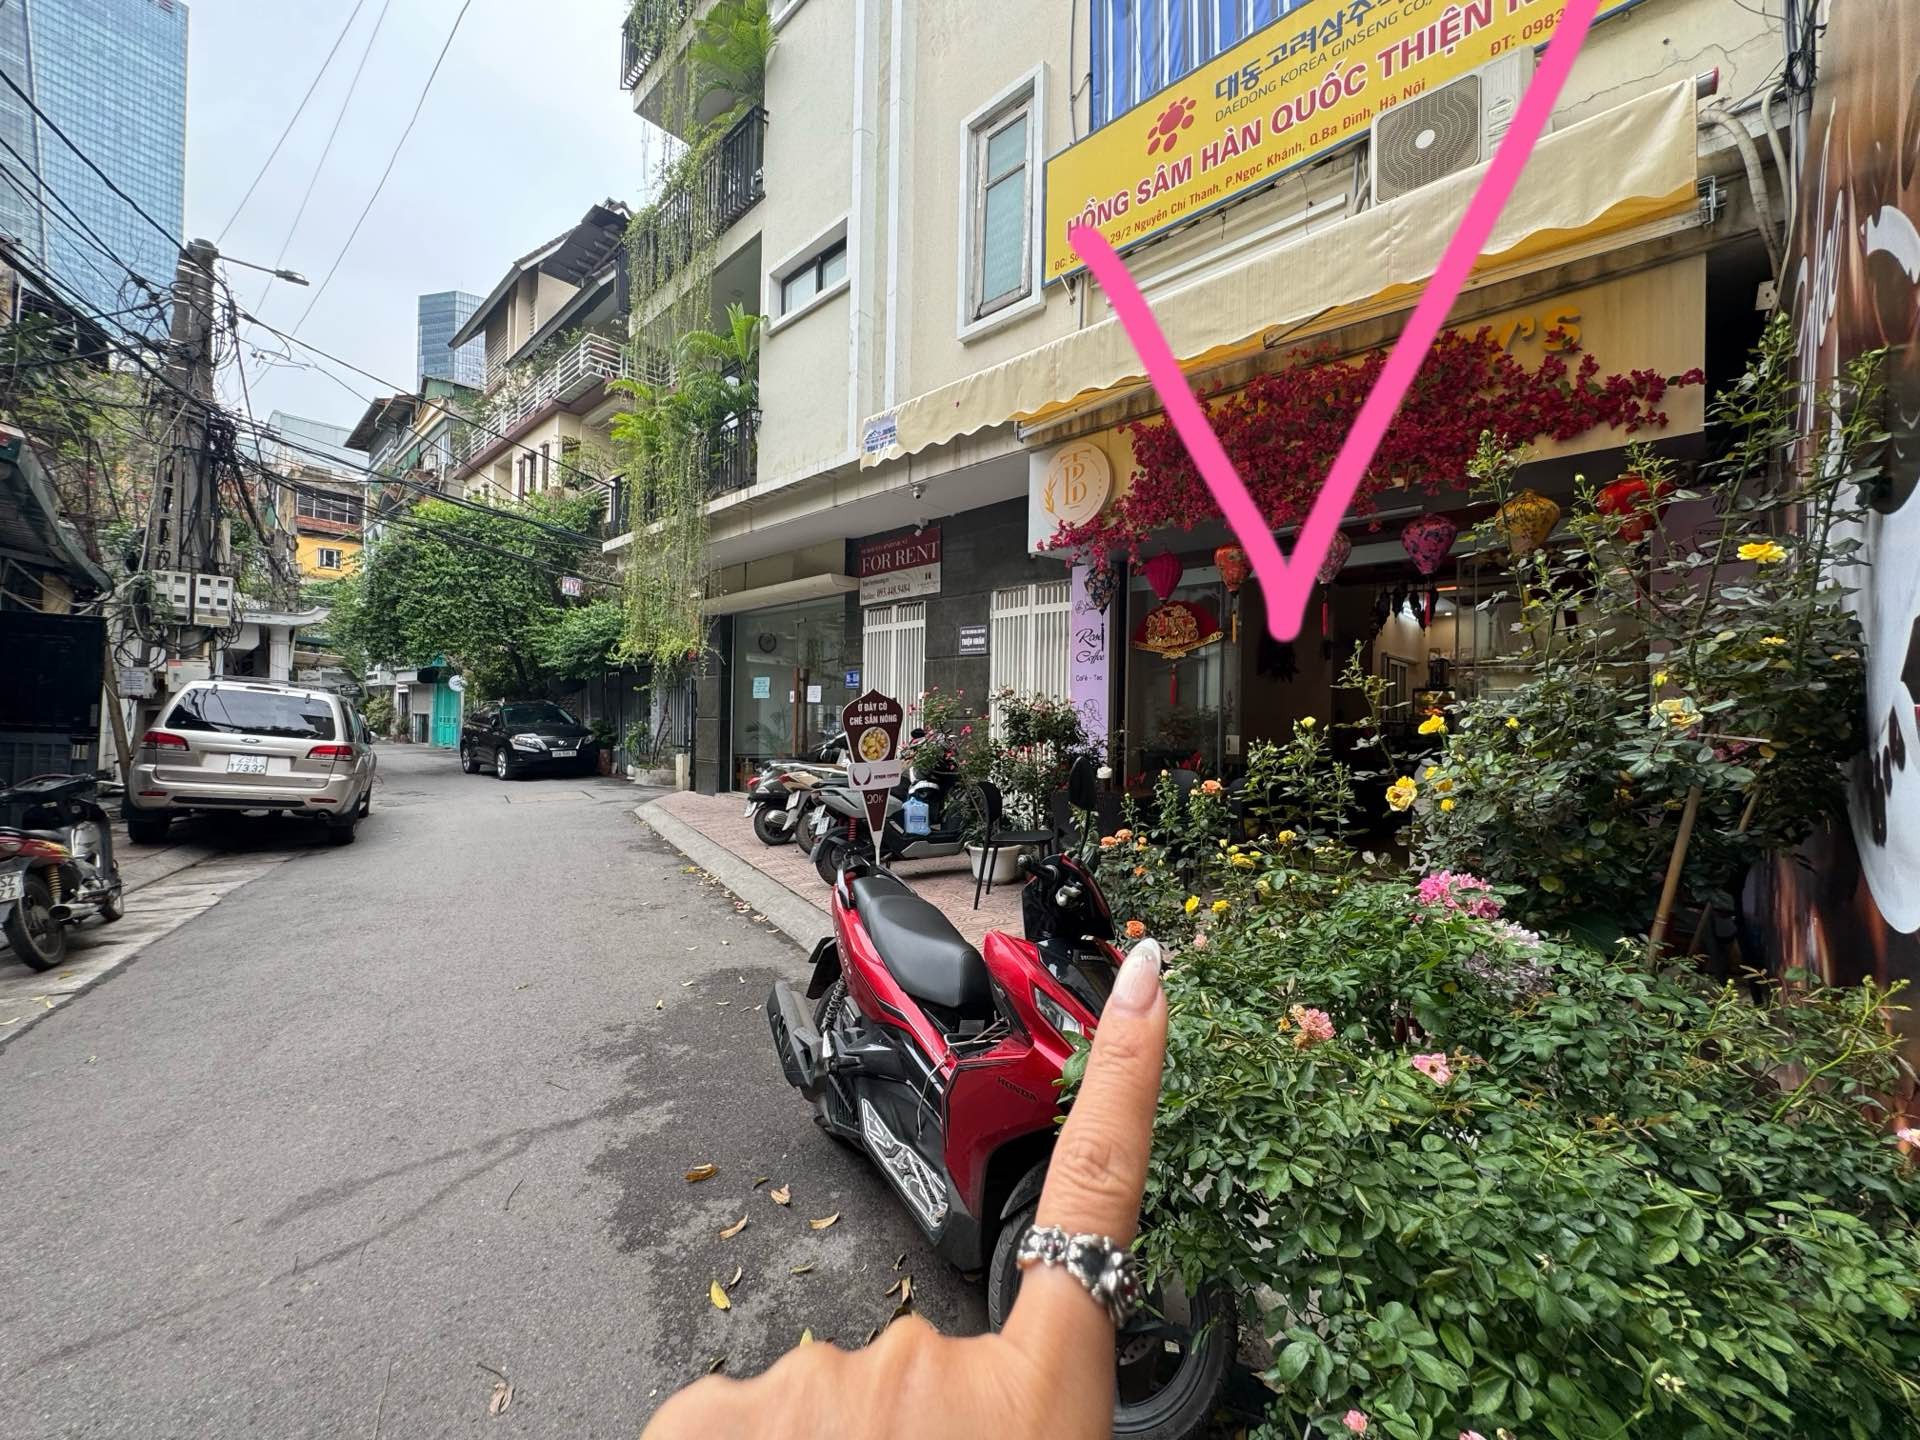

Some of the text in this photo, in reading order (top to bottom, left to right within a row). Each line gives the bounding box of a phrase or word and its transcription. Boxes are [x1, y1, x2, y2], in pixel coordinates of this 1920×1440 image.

[1491, 34, 1516, 56] ĐT:
[1215, 80, 1277, 122] DAEDONG
[1280, 53, 1327, 86] KOREA
[1331, 11, 1398, 57] GINSENG
[1136, 155, 1192, 205] SÂM
[1201, 119, 1262, 172] HÀN
[1271, 60, 1367, 134] QUỐC
[1377, 0, 1492, 79] THIỆN
[1110, 226, 1131, 245] 29/2
[1171, 197, 1186, 214] Chí
[1190, 184, 1221, 206] Thanh,
[1225, 162, 1263, 187] P.Ngọc
[1267, 142, 1305, 167] Khánh,
[1310, 126, 1338, 146] Q.Ba
[1342, 108, 1374, 129] Đình,
[1379, 95, 1397, 112] Hà
[1403, 78, 1426, 98] Nội
[862, 552, 892, 574] FOR
[895, 540, 940, 567] RENT
[1075, 649, 1105, 664] Coffee
[864, 702, 877, 712] ĐÂY
[878, 701, 888, 711] CÓ
[879, 713, 898, 724] NÓNG
[997, 1075, 1038, 1103] HONDA
